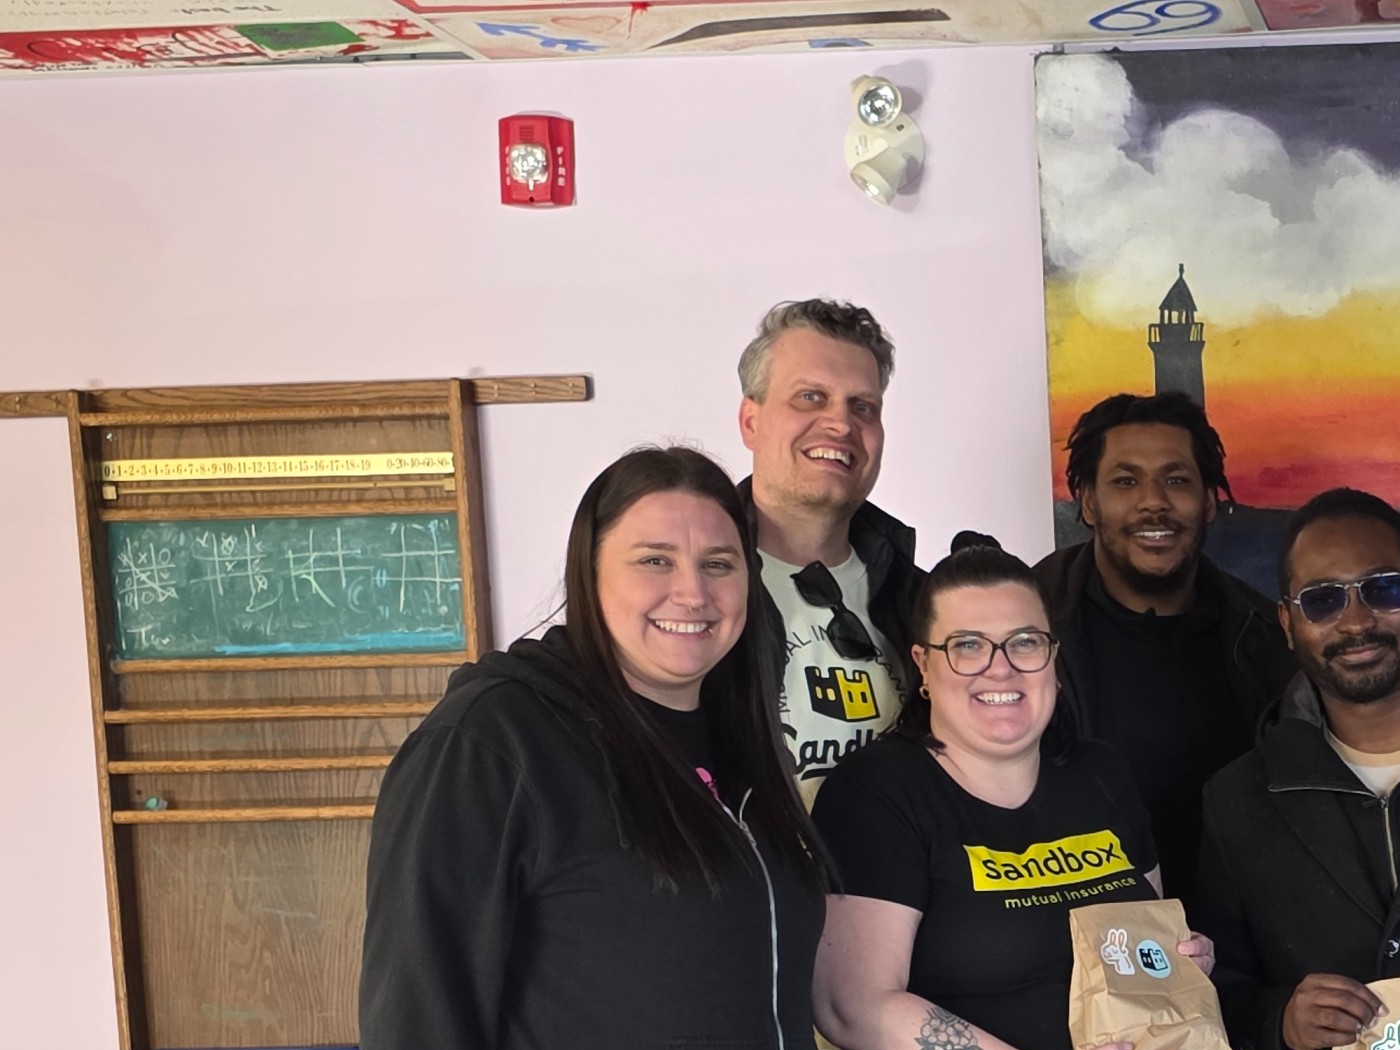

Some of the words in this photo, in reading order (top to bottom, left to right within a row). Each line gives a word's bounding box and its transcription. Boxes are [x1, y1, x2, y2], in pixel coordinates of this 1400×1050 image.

[781, 723, 876, 772] and
[1005, 892, 1063, 909] mutual
[1064, 877, 1137, 900] insurance
